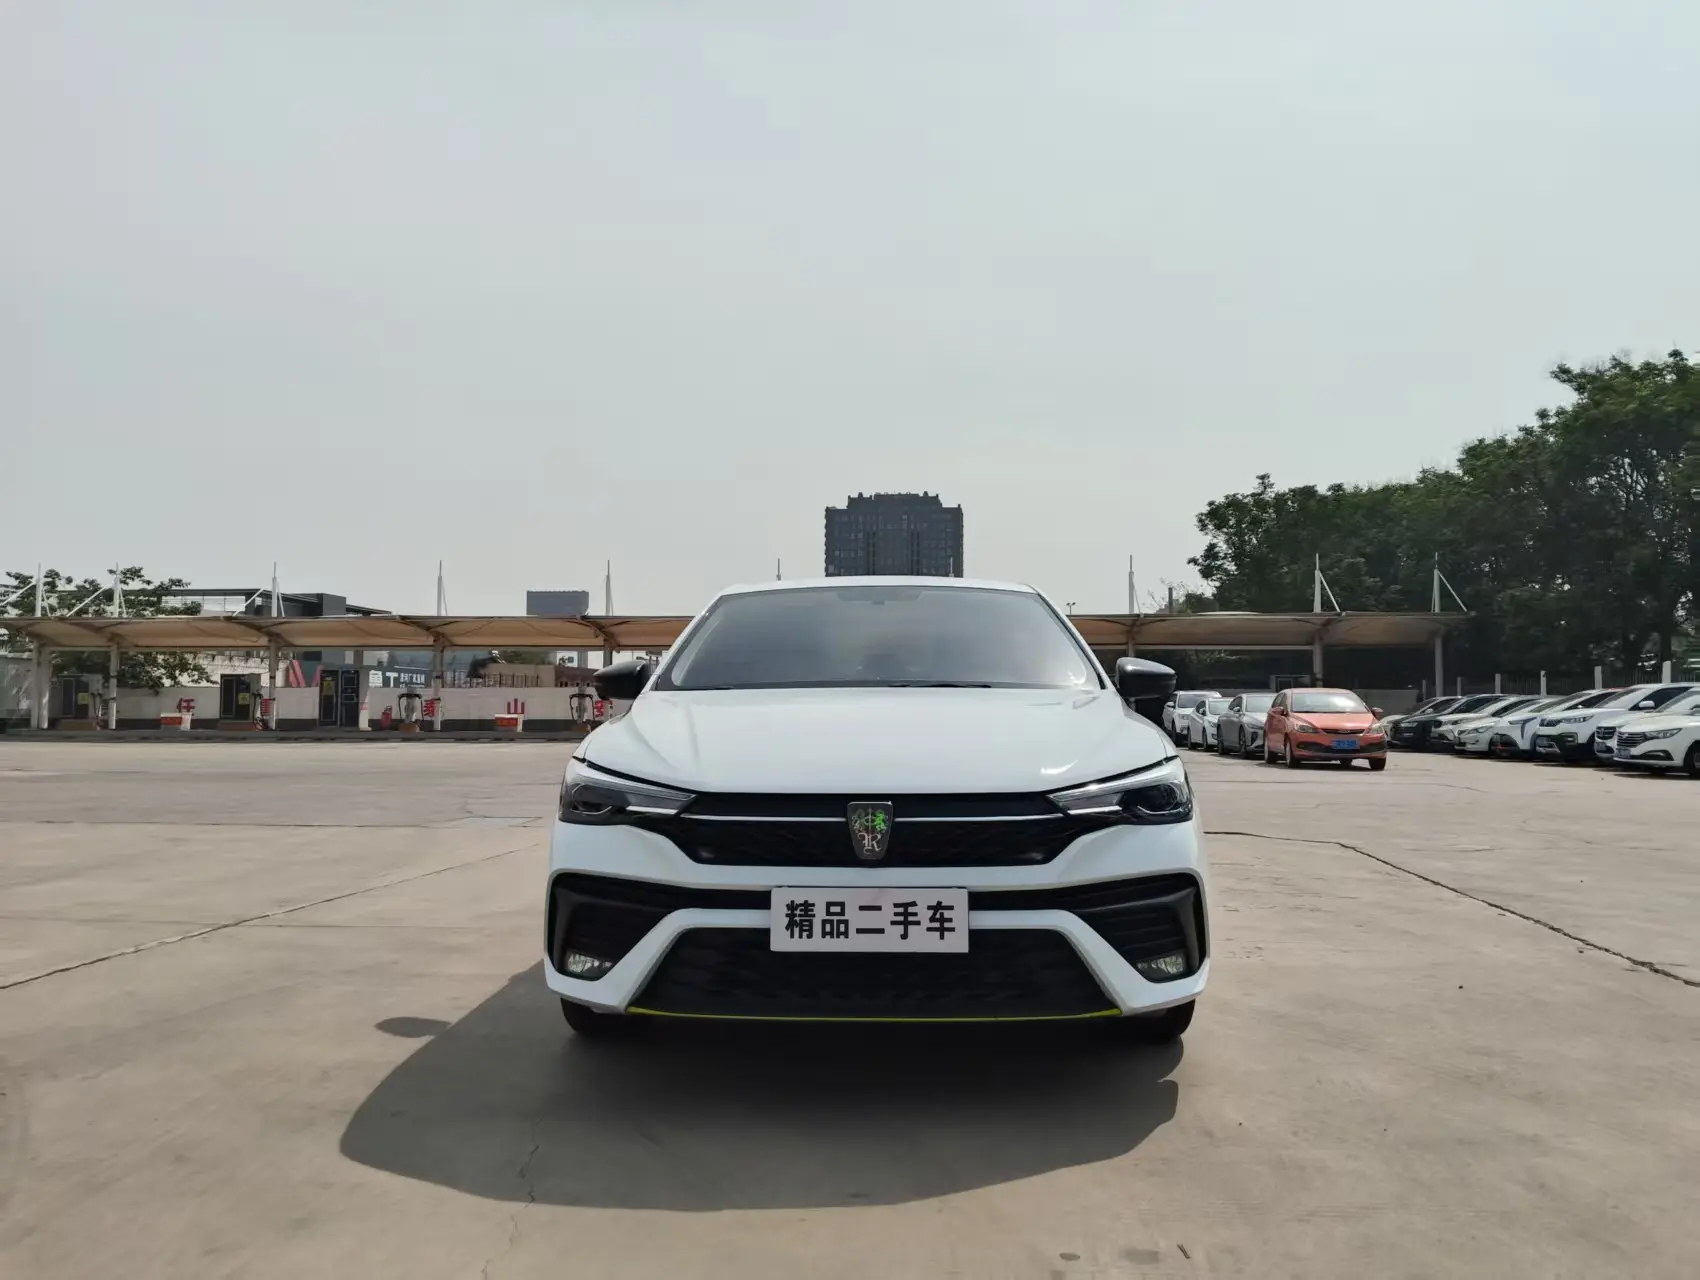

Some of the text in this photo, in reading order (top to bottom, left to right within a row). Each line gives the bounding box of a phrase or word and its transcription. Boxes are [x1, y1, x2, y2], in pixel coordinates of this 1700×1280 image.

[785, 900, 956, 940] 精品二手车
